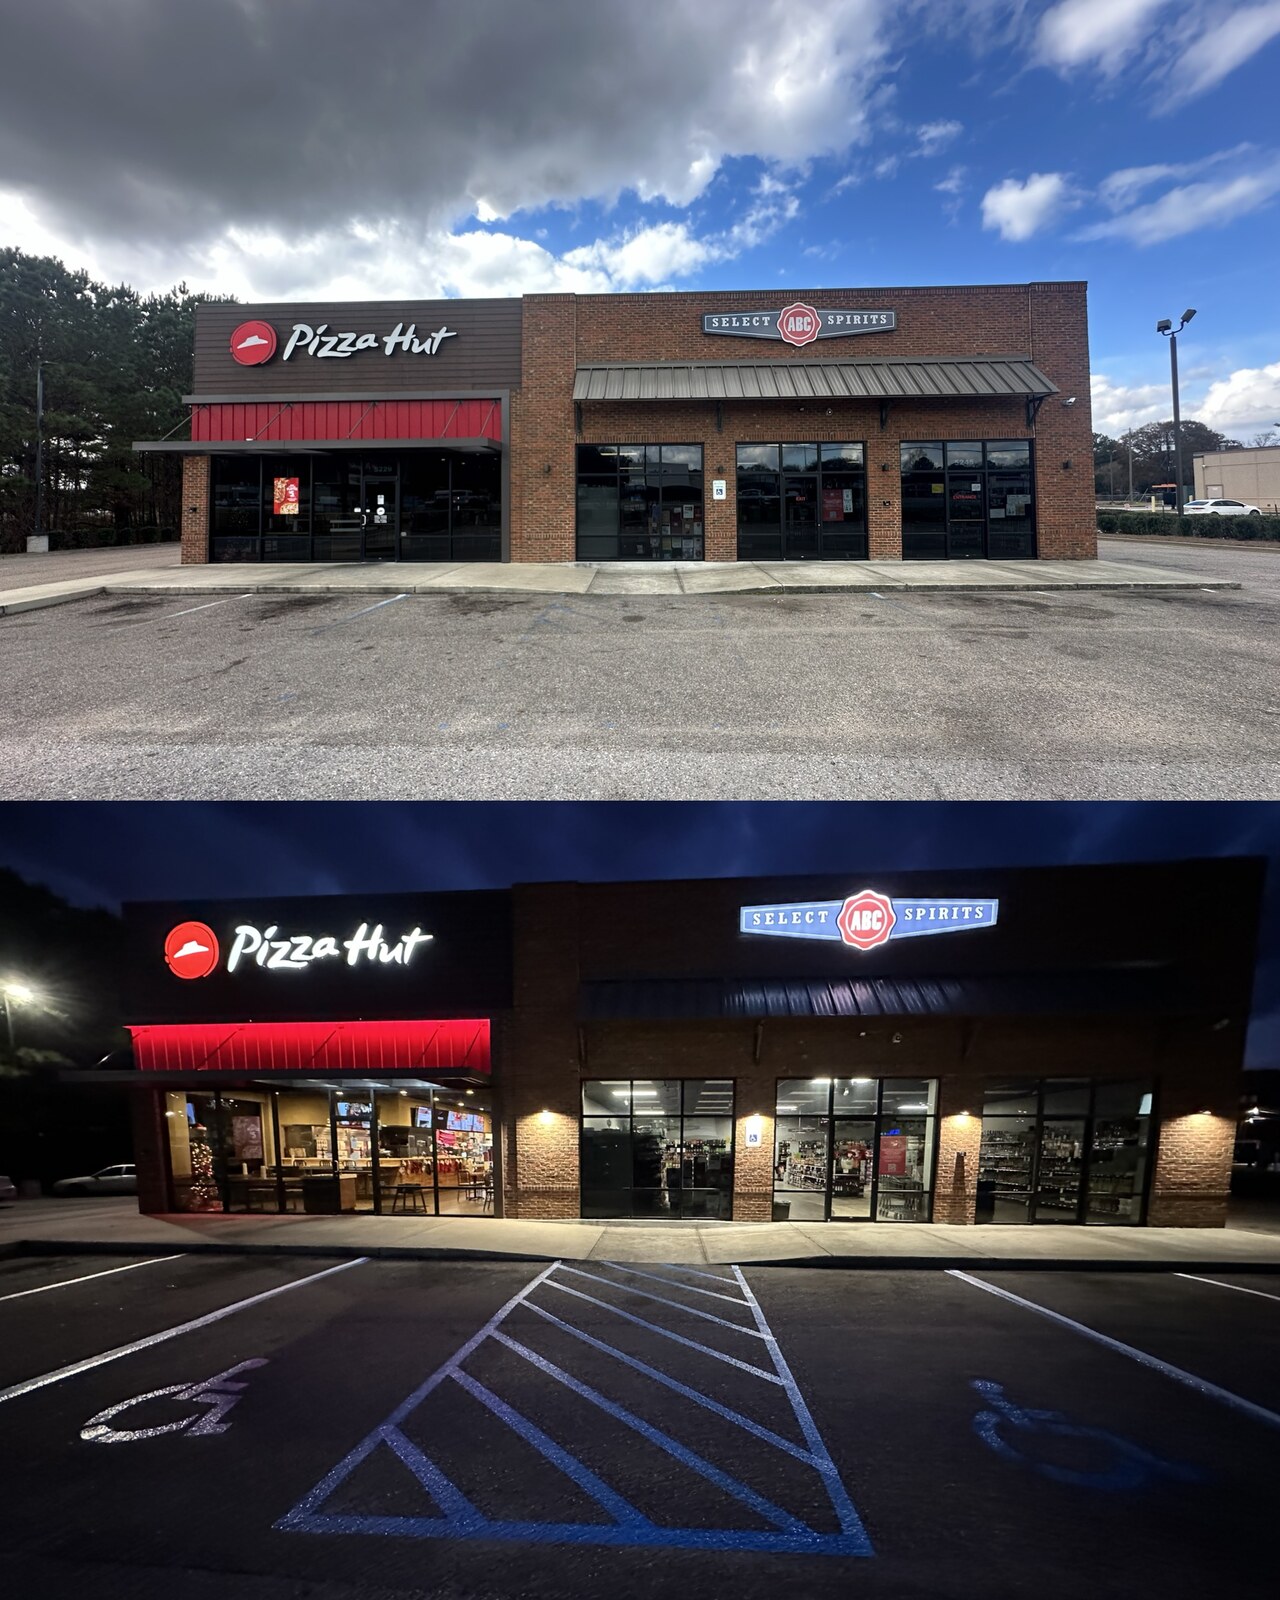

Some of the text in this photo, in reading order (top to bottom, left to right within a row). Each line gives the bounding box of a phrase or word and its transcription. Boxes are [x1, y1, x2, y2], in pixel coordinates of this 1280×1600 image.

[712, 314, 887, 332] SELECT ABC SPIRITS
[282, 322, 458, 361] Pizza Hut
[752, 906, 985, 932] SELECT ABC SPIRITS
[227, 922, 435, 973] Pizza Hut
